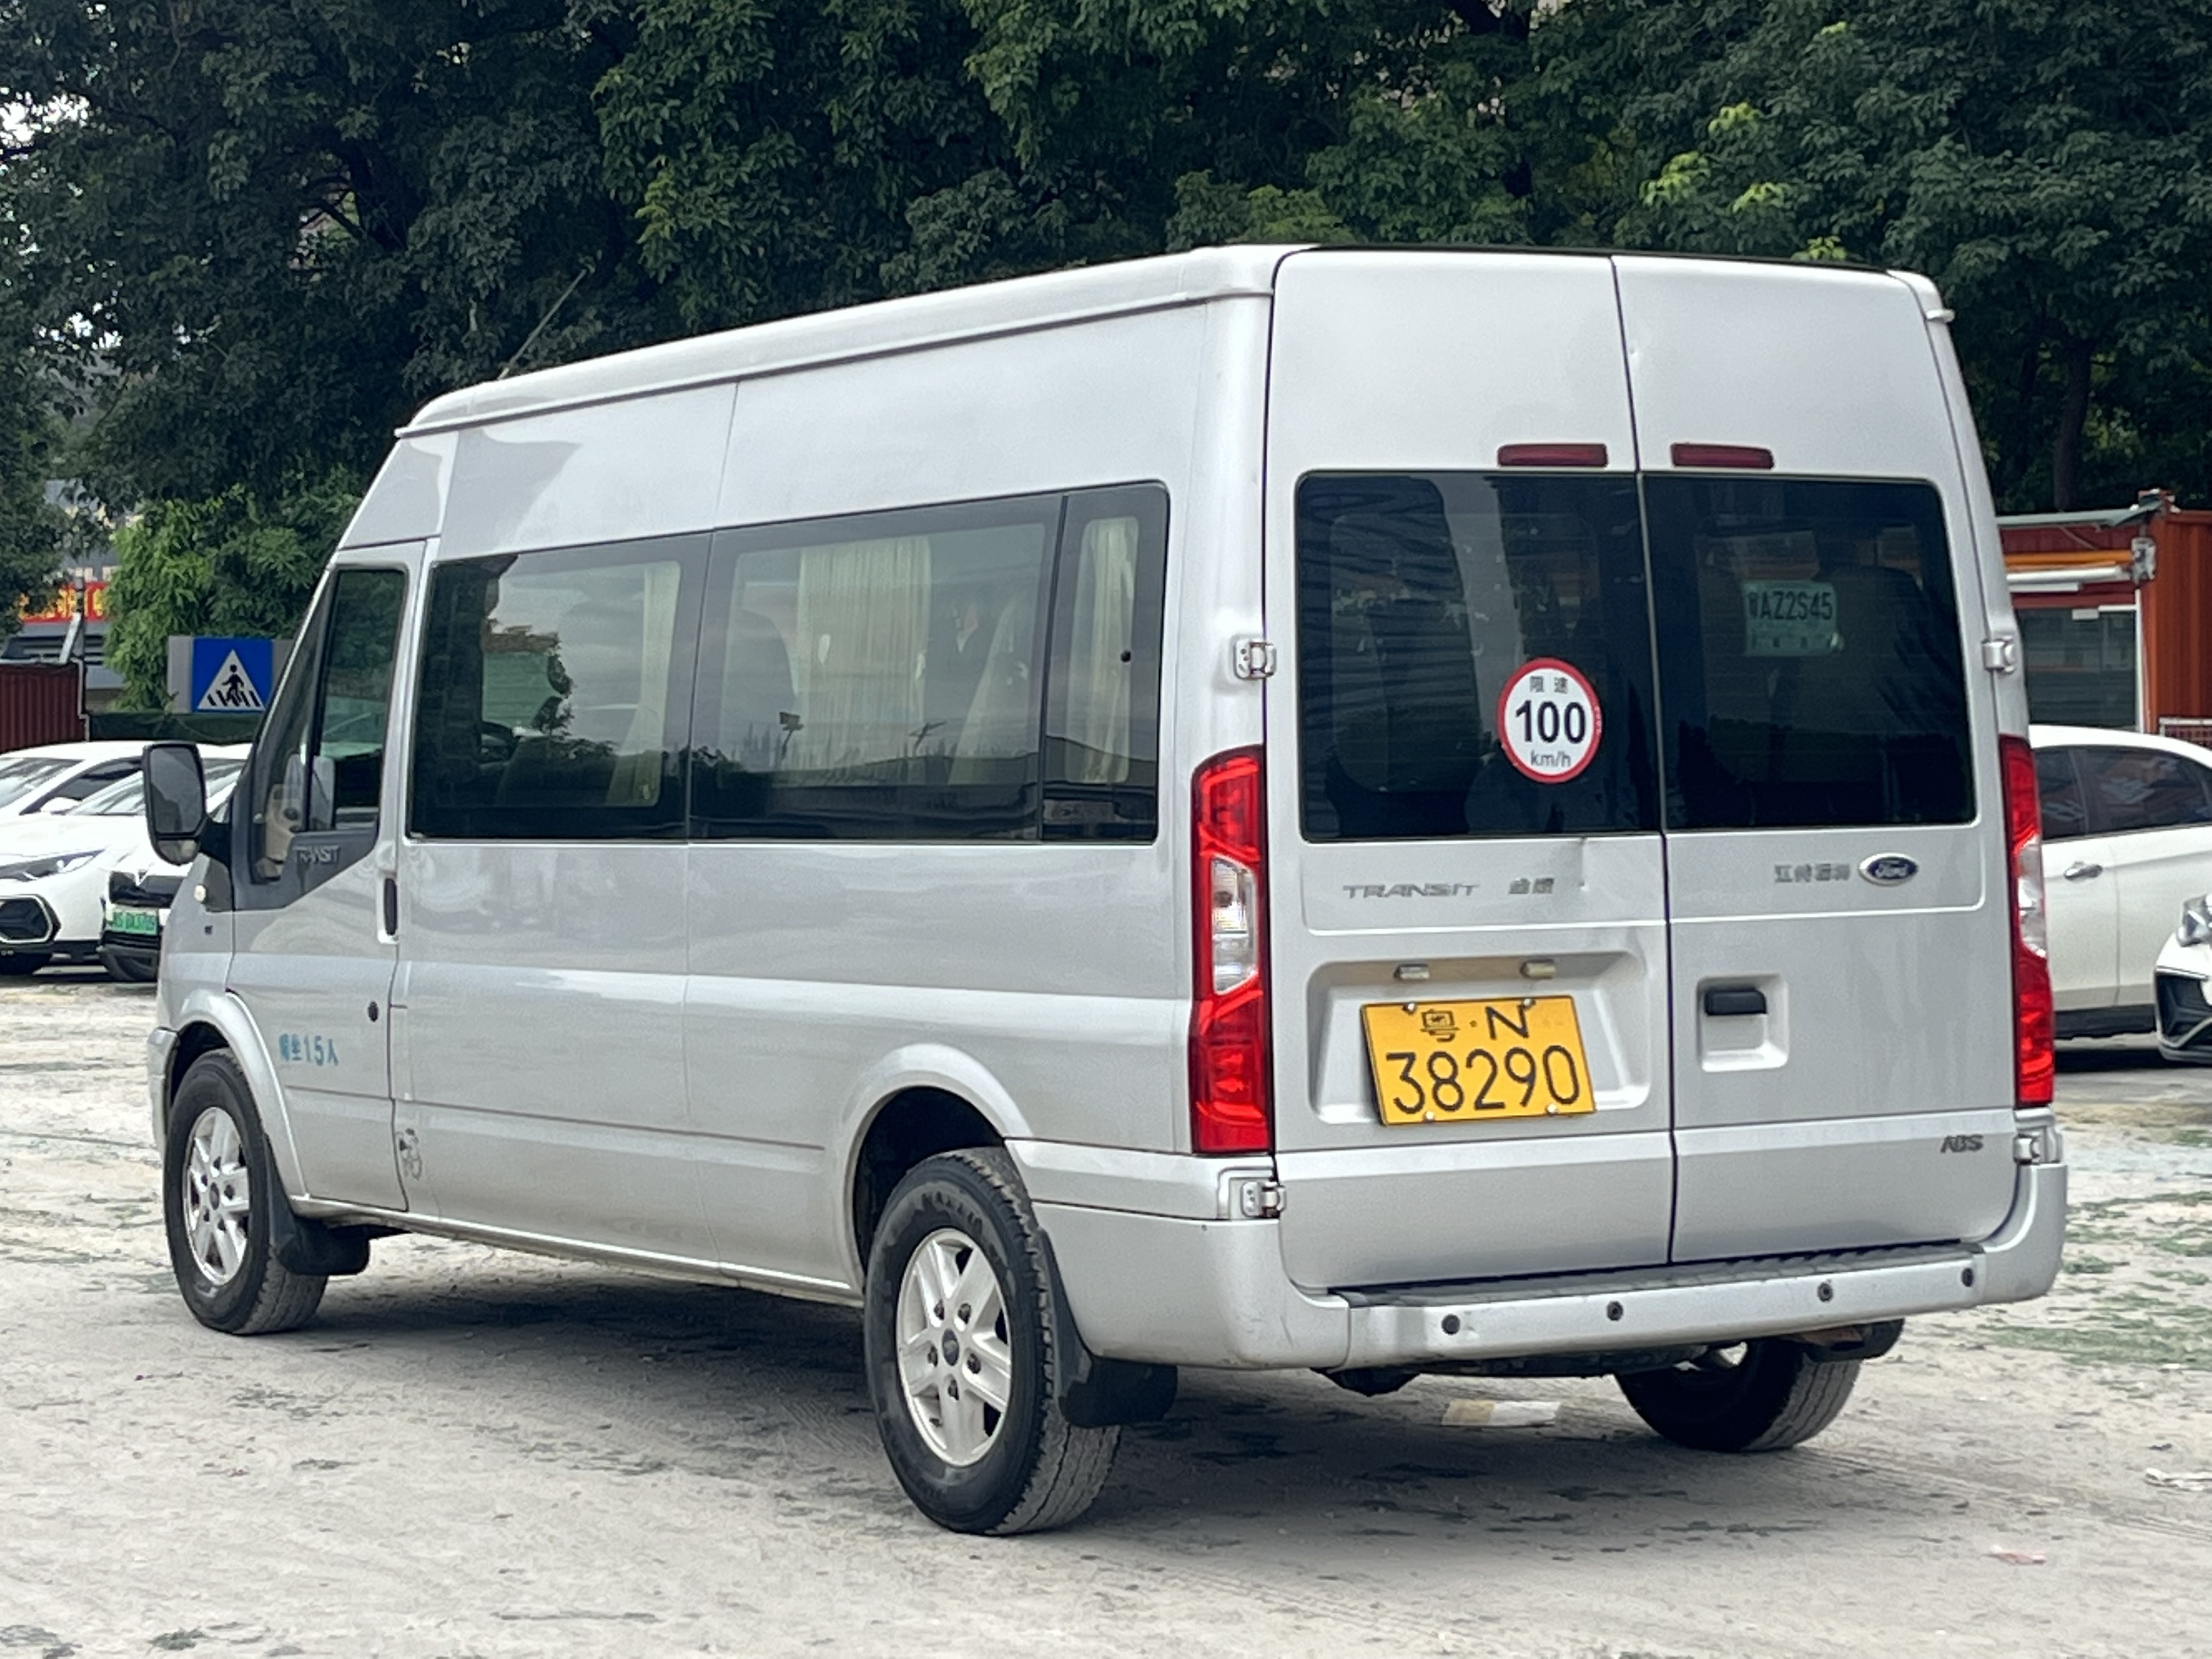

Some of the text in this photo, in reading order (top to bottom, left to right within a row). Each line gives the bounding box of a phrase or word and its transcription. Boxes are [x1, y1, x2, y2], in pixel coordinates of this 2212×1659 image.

[1530, 675, 1568, 694] 限速
[1516, 699, 1587, 744] 100
[1531, 750, 1571, 768] km/h
[1342, 883, 1480, 899] TRANSIT
[1386, 1045, 1581, 1114] 38290
[1940, 1134, 1984, 1154] ABS
